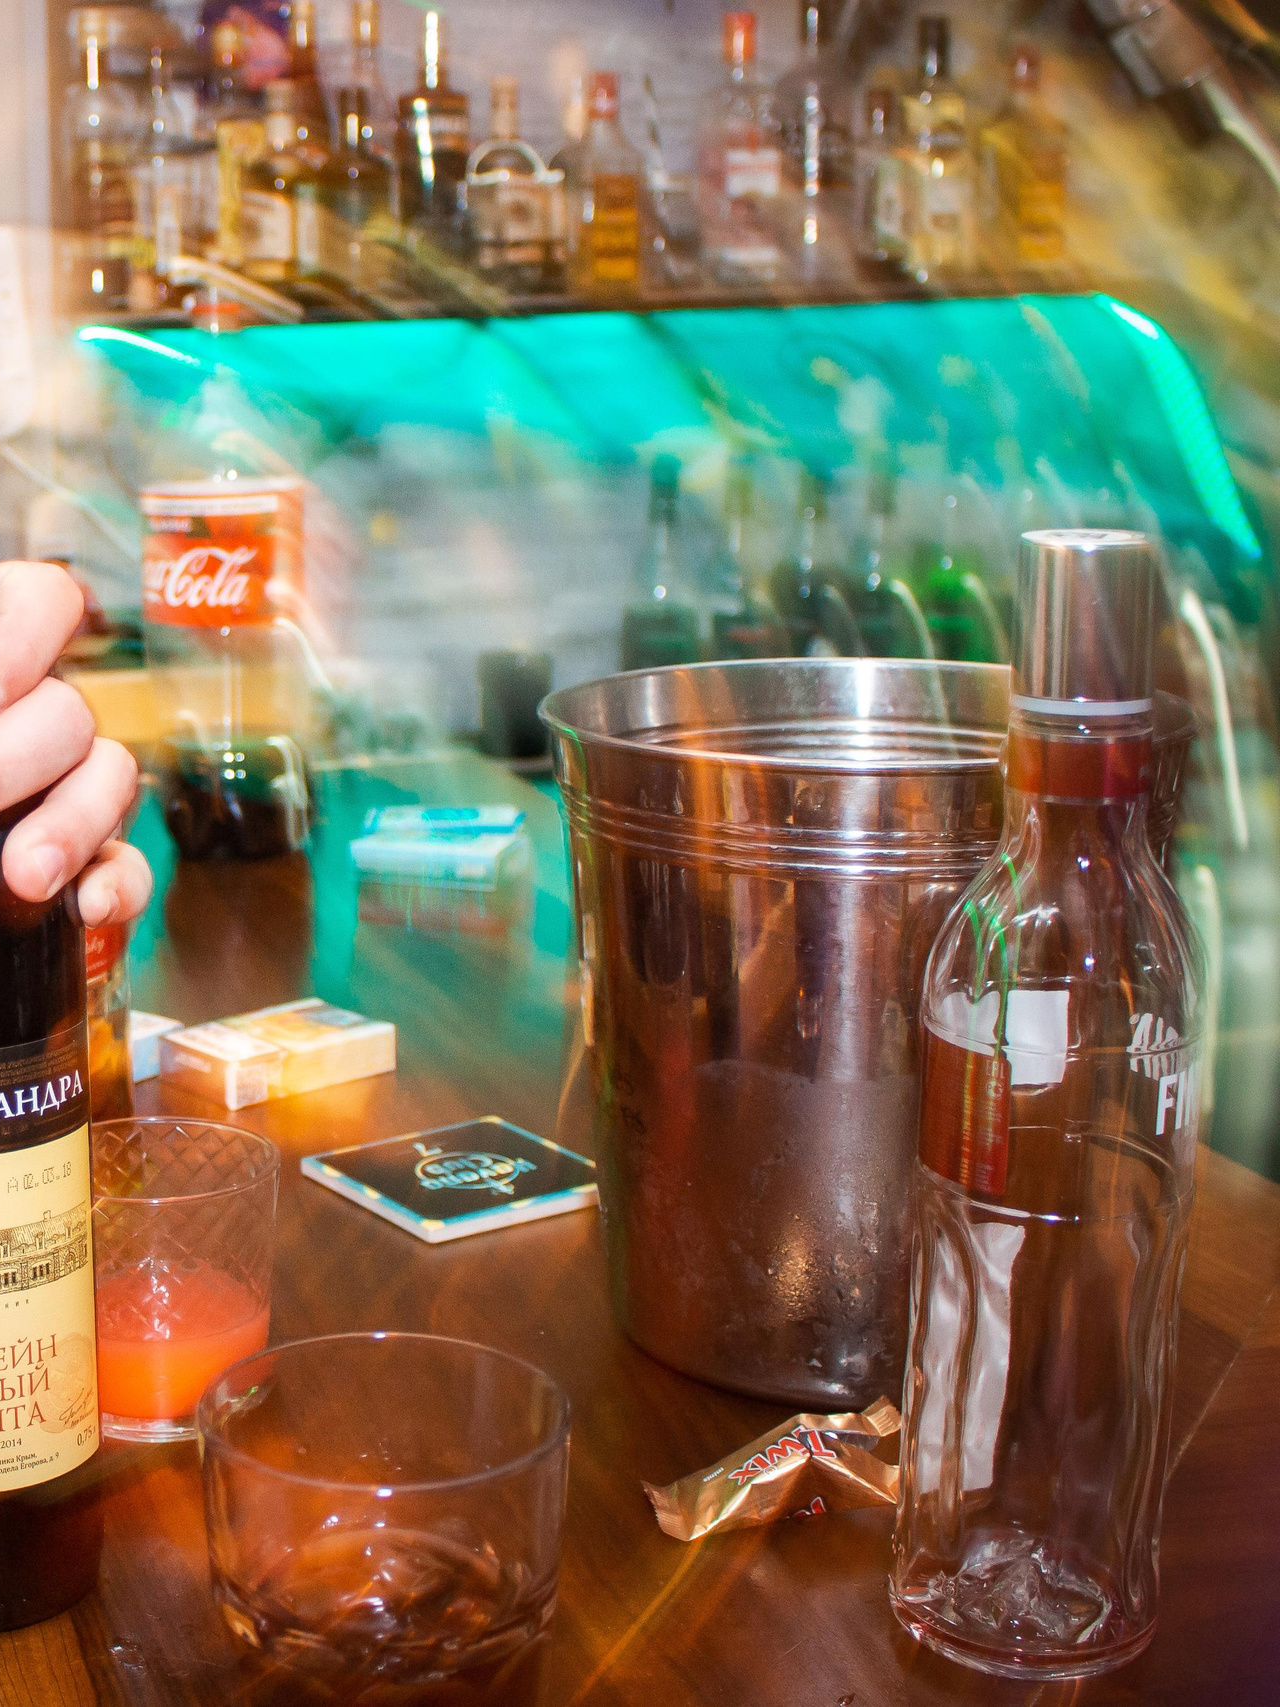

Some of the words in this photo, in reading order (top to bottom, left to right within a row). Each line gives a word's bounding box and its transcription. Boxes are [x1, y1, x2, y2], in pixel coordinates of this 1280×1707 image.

[76, 1425, 93, 1447] 0,75
[0, 1437, 23, 1450] 2014
[16, 1452, 38, 1463] Крым,
[20, 1457, 49, 1471] Егорова,
[702, 1466, 725, 1483] minis
